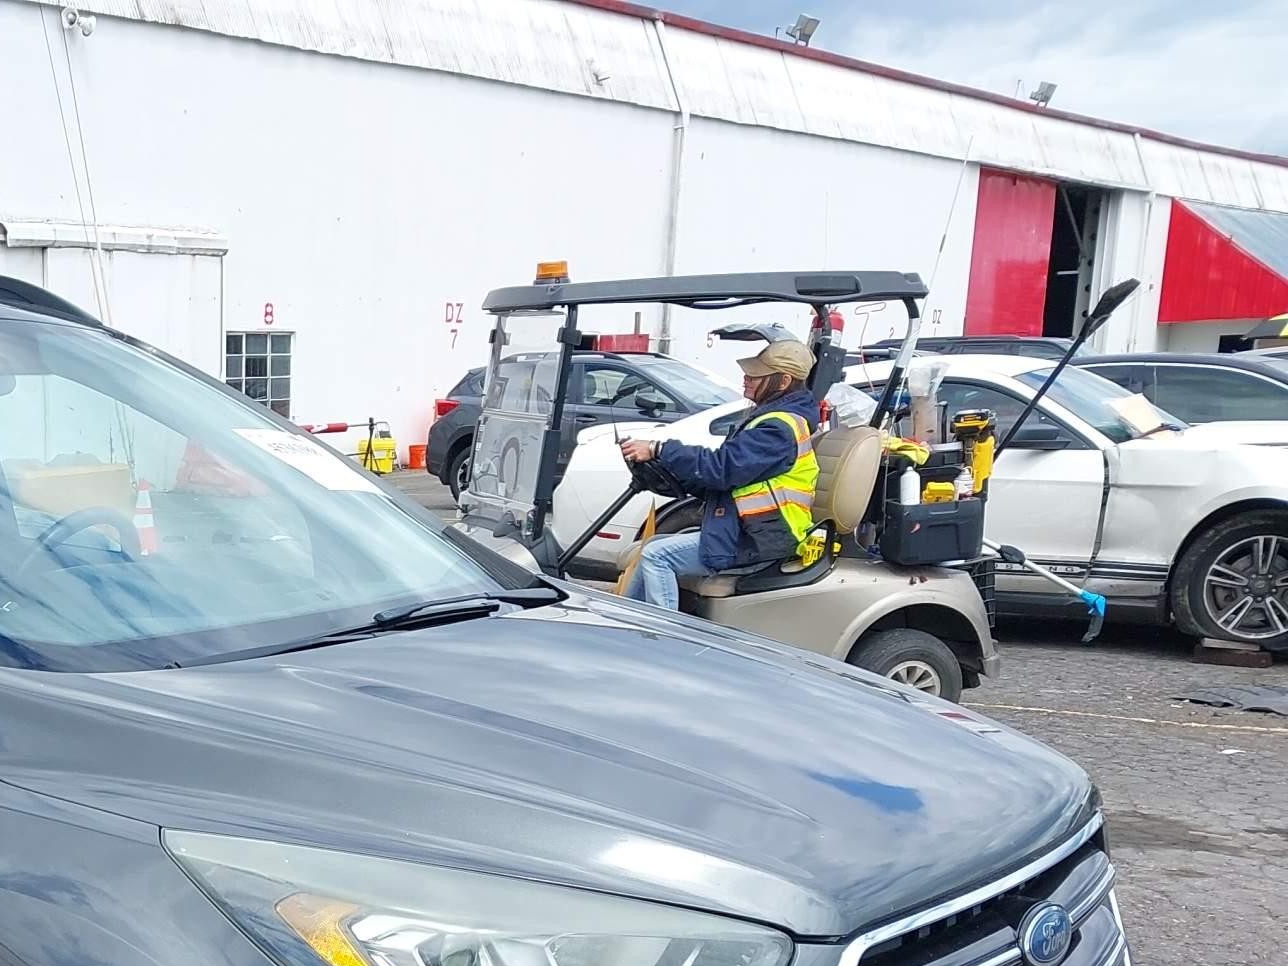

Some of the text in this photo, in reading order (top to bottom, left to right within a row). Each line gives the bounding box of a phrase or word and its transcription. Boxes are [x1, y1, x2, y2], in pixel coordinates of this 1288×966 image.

[264, 303, 274, 325] 8
[445, 302, 464, 324] DZ
[450, 329, 458, 350] 7
[1042, 918, 1067, 956] Ford
